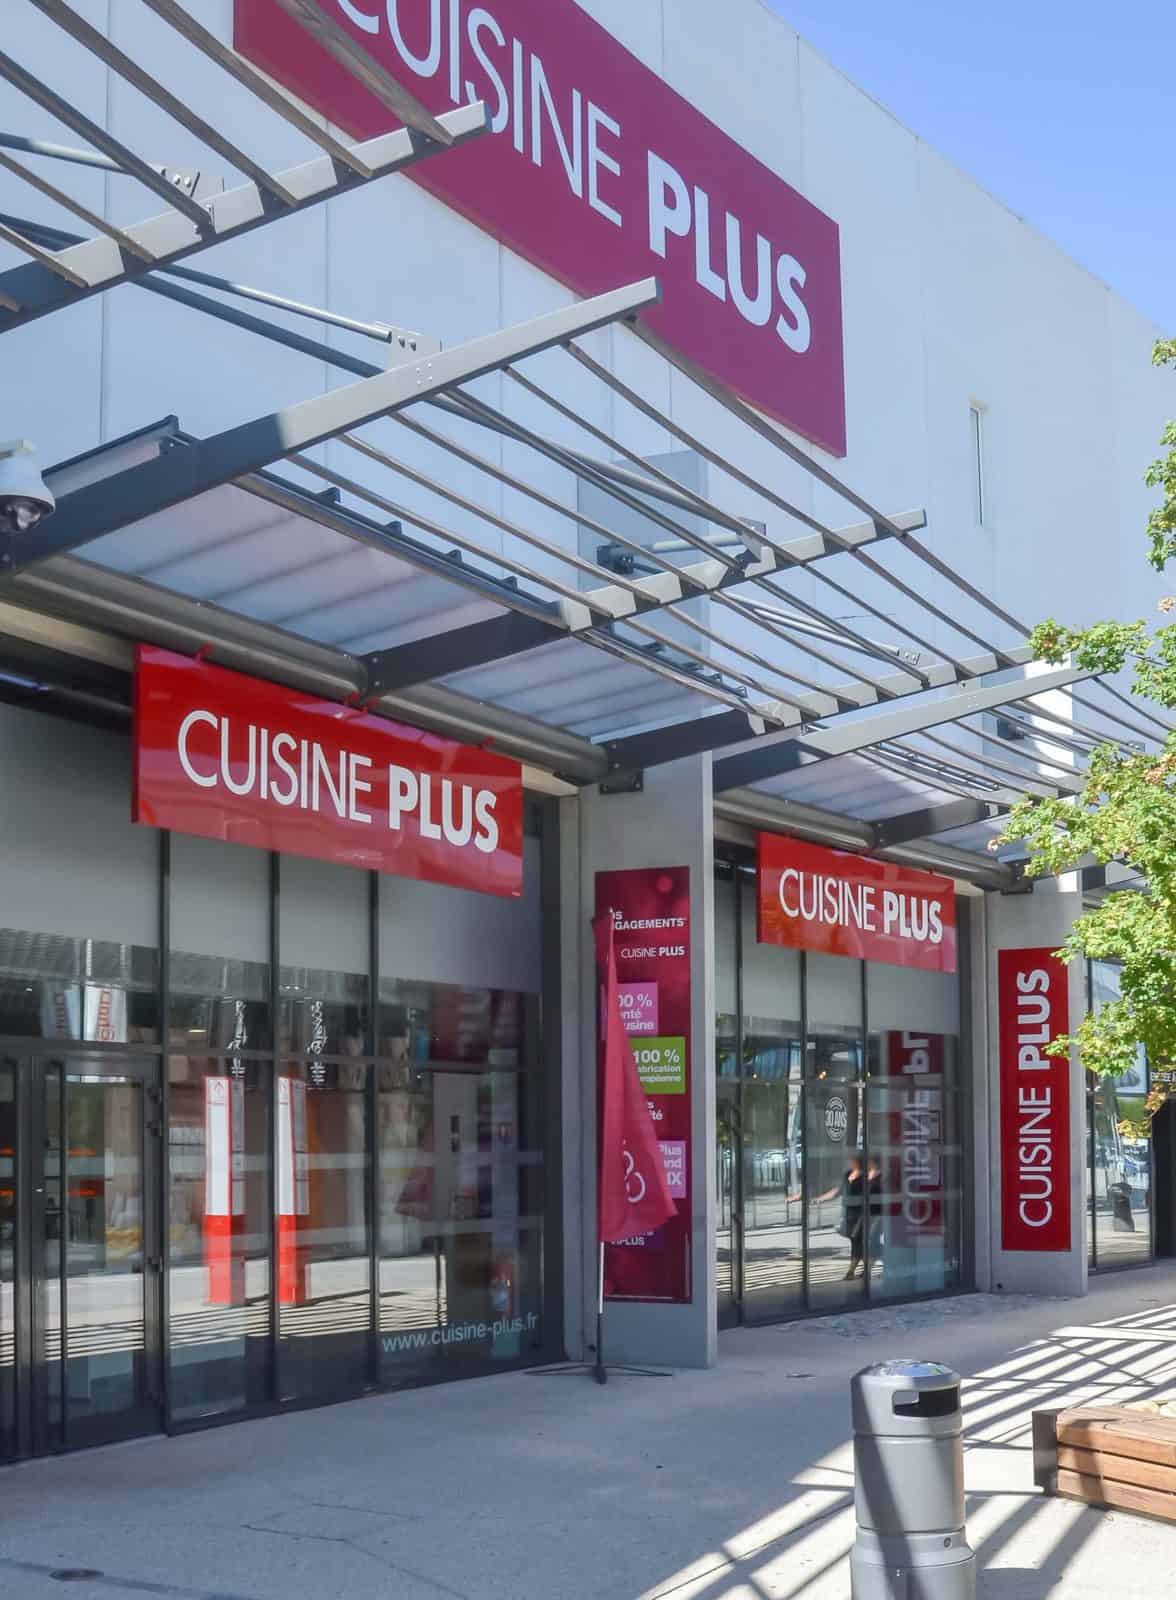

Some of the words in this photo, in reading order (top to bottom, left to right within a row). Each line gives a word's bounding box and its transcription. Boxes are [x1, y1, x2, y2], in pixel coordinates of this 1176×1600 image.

[338, 0, 622, 227] UISINE
[647, 150, 812, 353] PLUS
[178, 710, 372, 823] CUISINE
[389, 765, 499, 852] PLUS
[779, 868, 876, 931] CUISINE
[883, 890, 943, 943] PLUS
[621, 948, 656, 959] CUISINE
[659, 945, 685, 956] PLUS
[637, 993, 652, 1007] %
[1016, 968, 1051, 1070] PLUS
[633, 1050, 660, 1063] 100
[664, 1049, 680, 1063] %
[1018, 1087, 1053, 1228] CUISINE
[382, 1311, 538, 1353] www.cuisine-plus.fr
